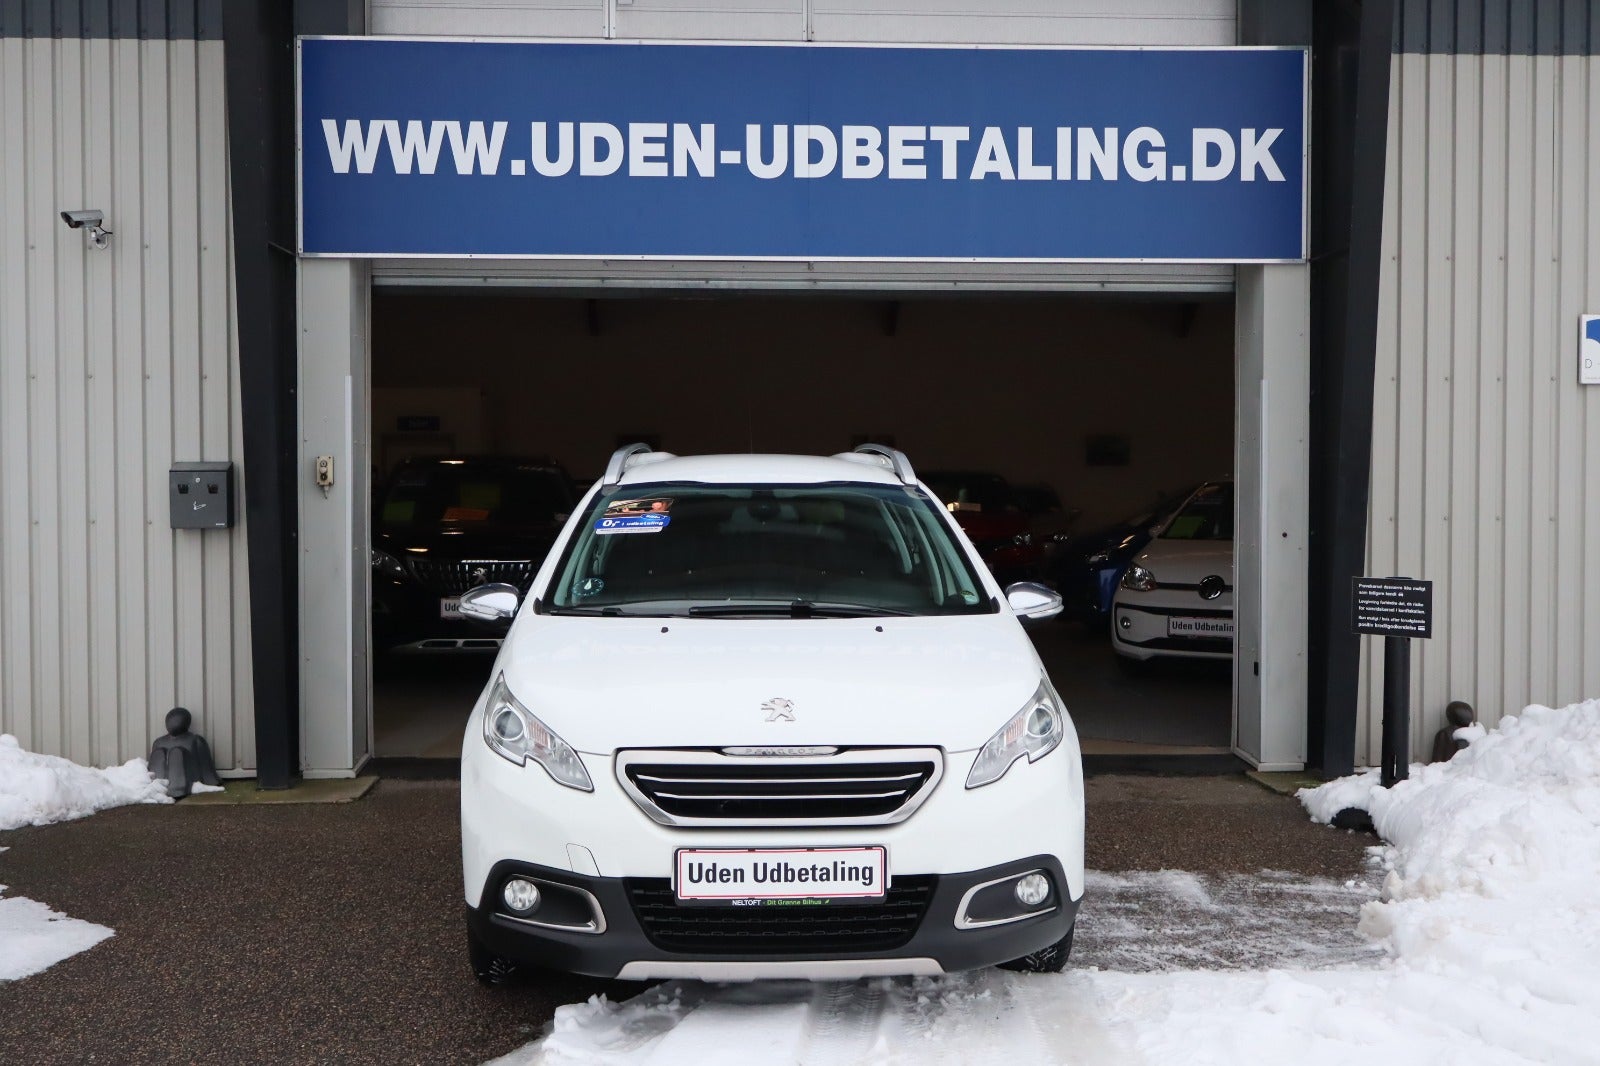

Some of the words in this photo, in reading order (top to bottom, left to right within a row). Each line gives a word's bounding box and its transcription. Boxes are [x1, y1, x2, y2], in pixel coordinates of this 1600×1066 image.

[321, 118, 1287, 183] WWW.UDEN-UDBETALING.DK
[1172, 621, 1193, 630] Uden
[688, 862, 745, 884] Uden
[753, 860, 874, 887] Udbetaling
